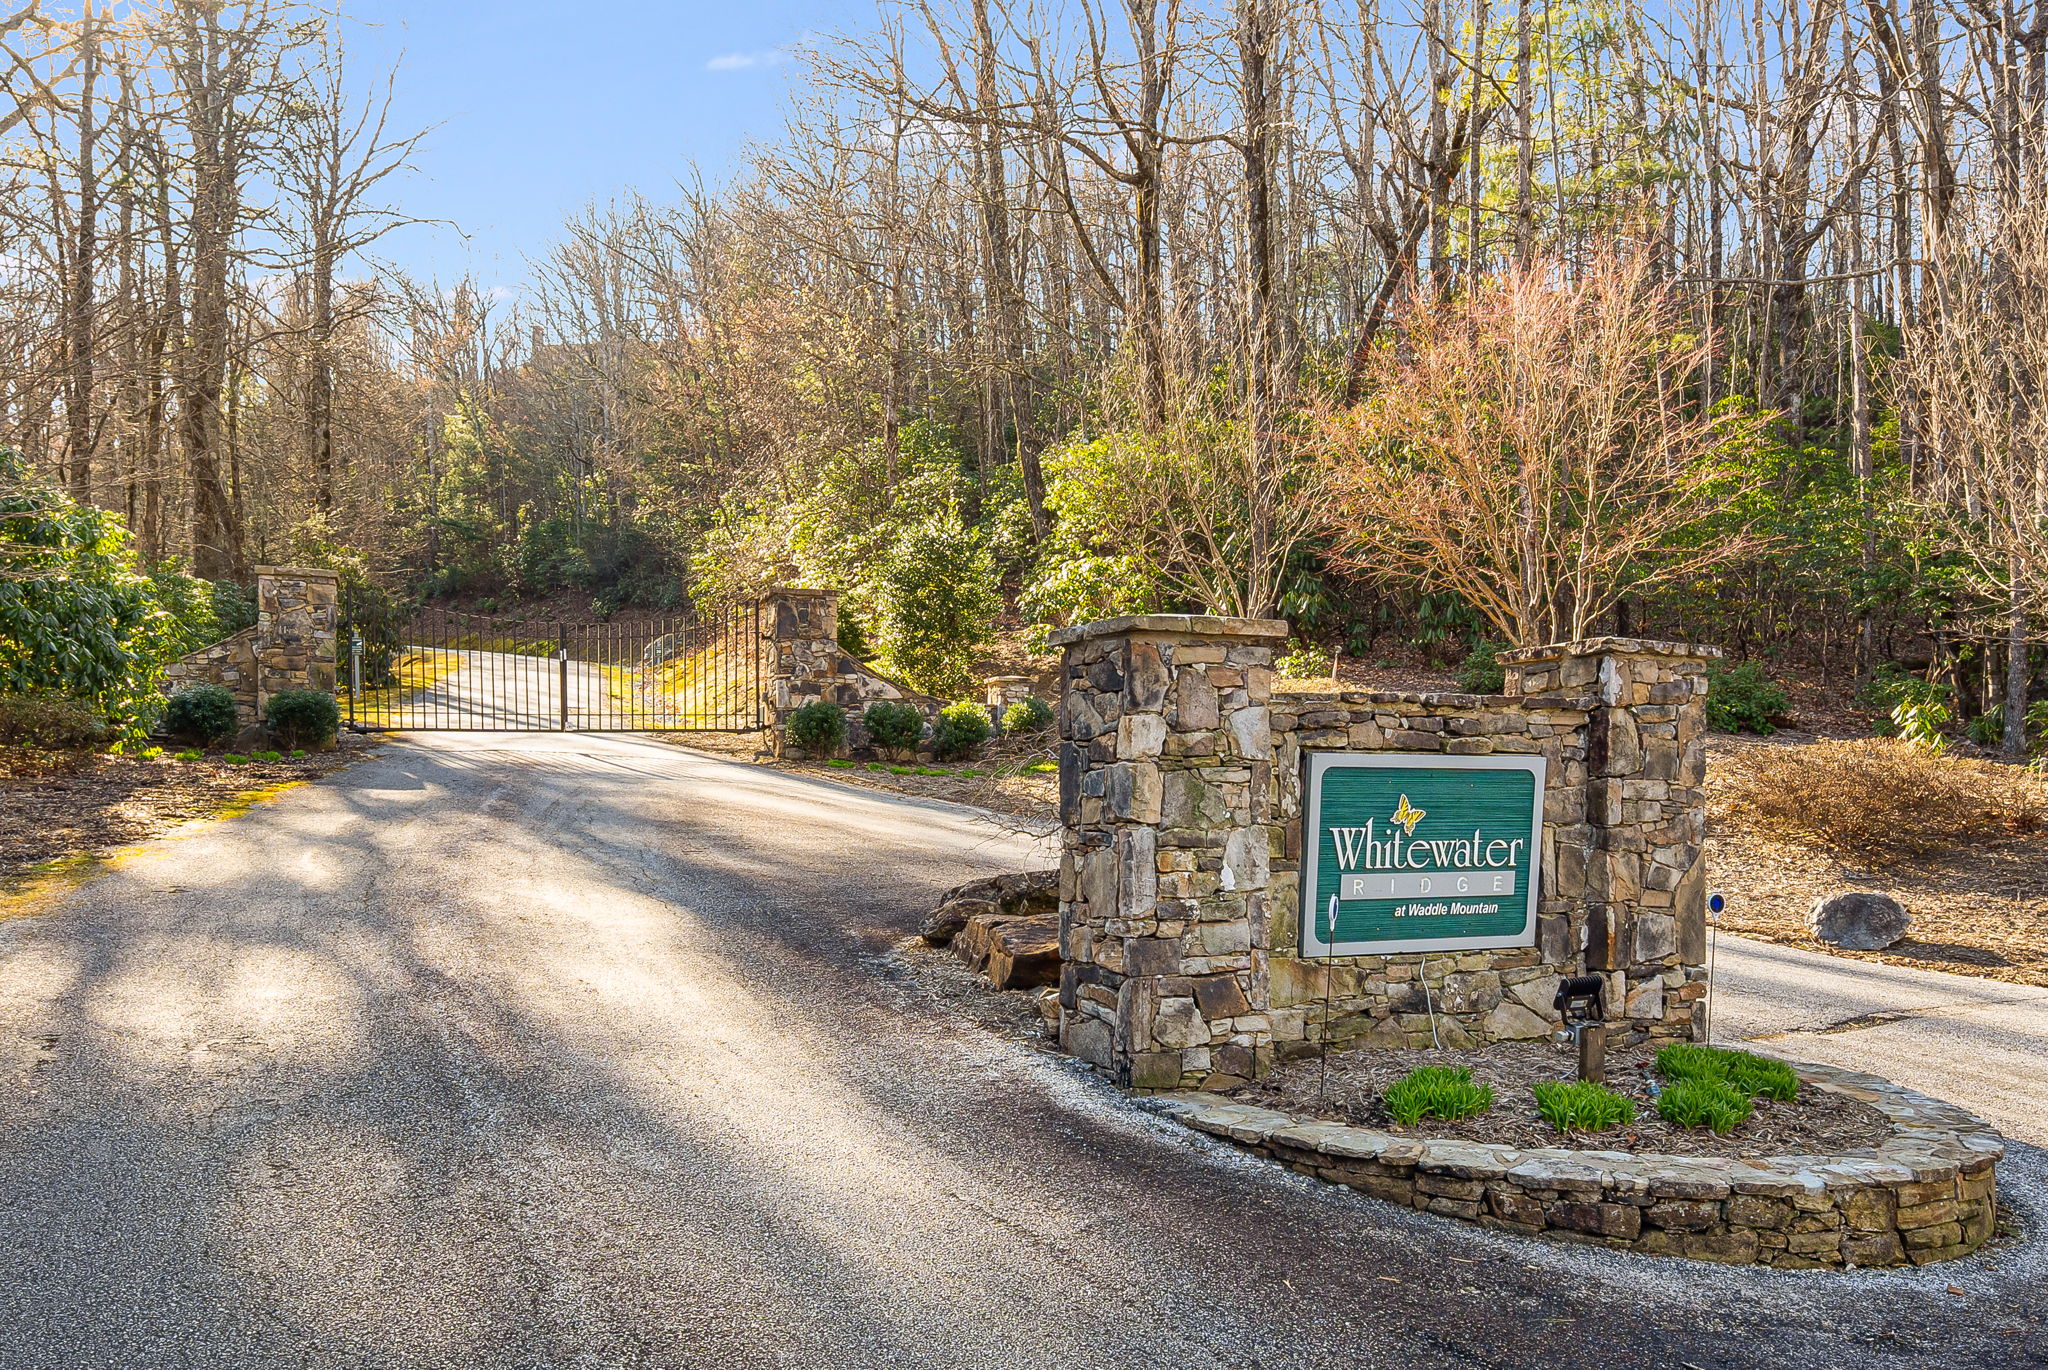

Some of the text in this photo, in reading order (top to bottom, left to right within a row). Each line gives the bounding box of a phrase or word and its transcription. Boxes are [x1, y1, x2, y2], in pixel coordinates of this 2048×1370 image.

[1329, 817, 1524, 870] Whitewater
[1353, 876, 1503, 895] RIDGE
[1394, 902, 1498, 917] at Waddle Mountain
